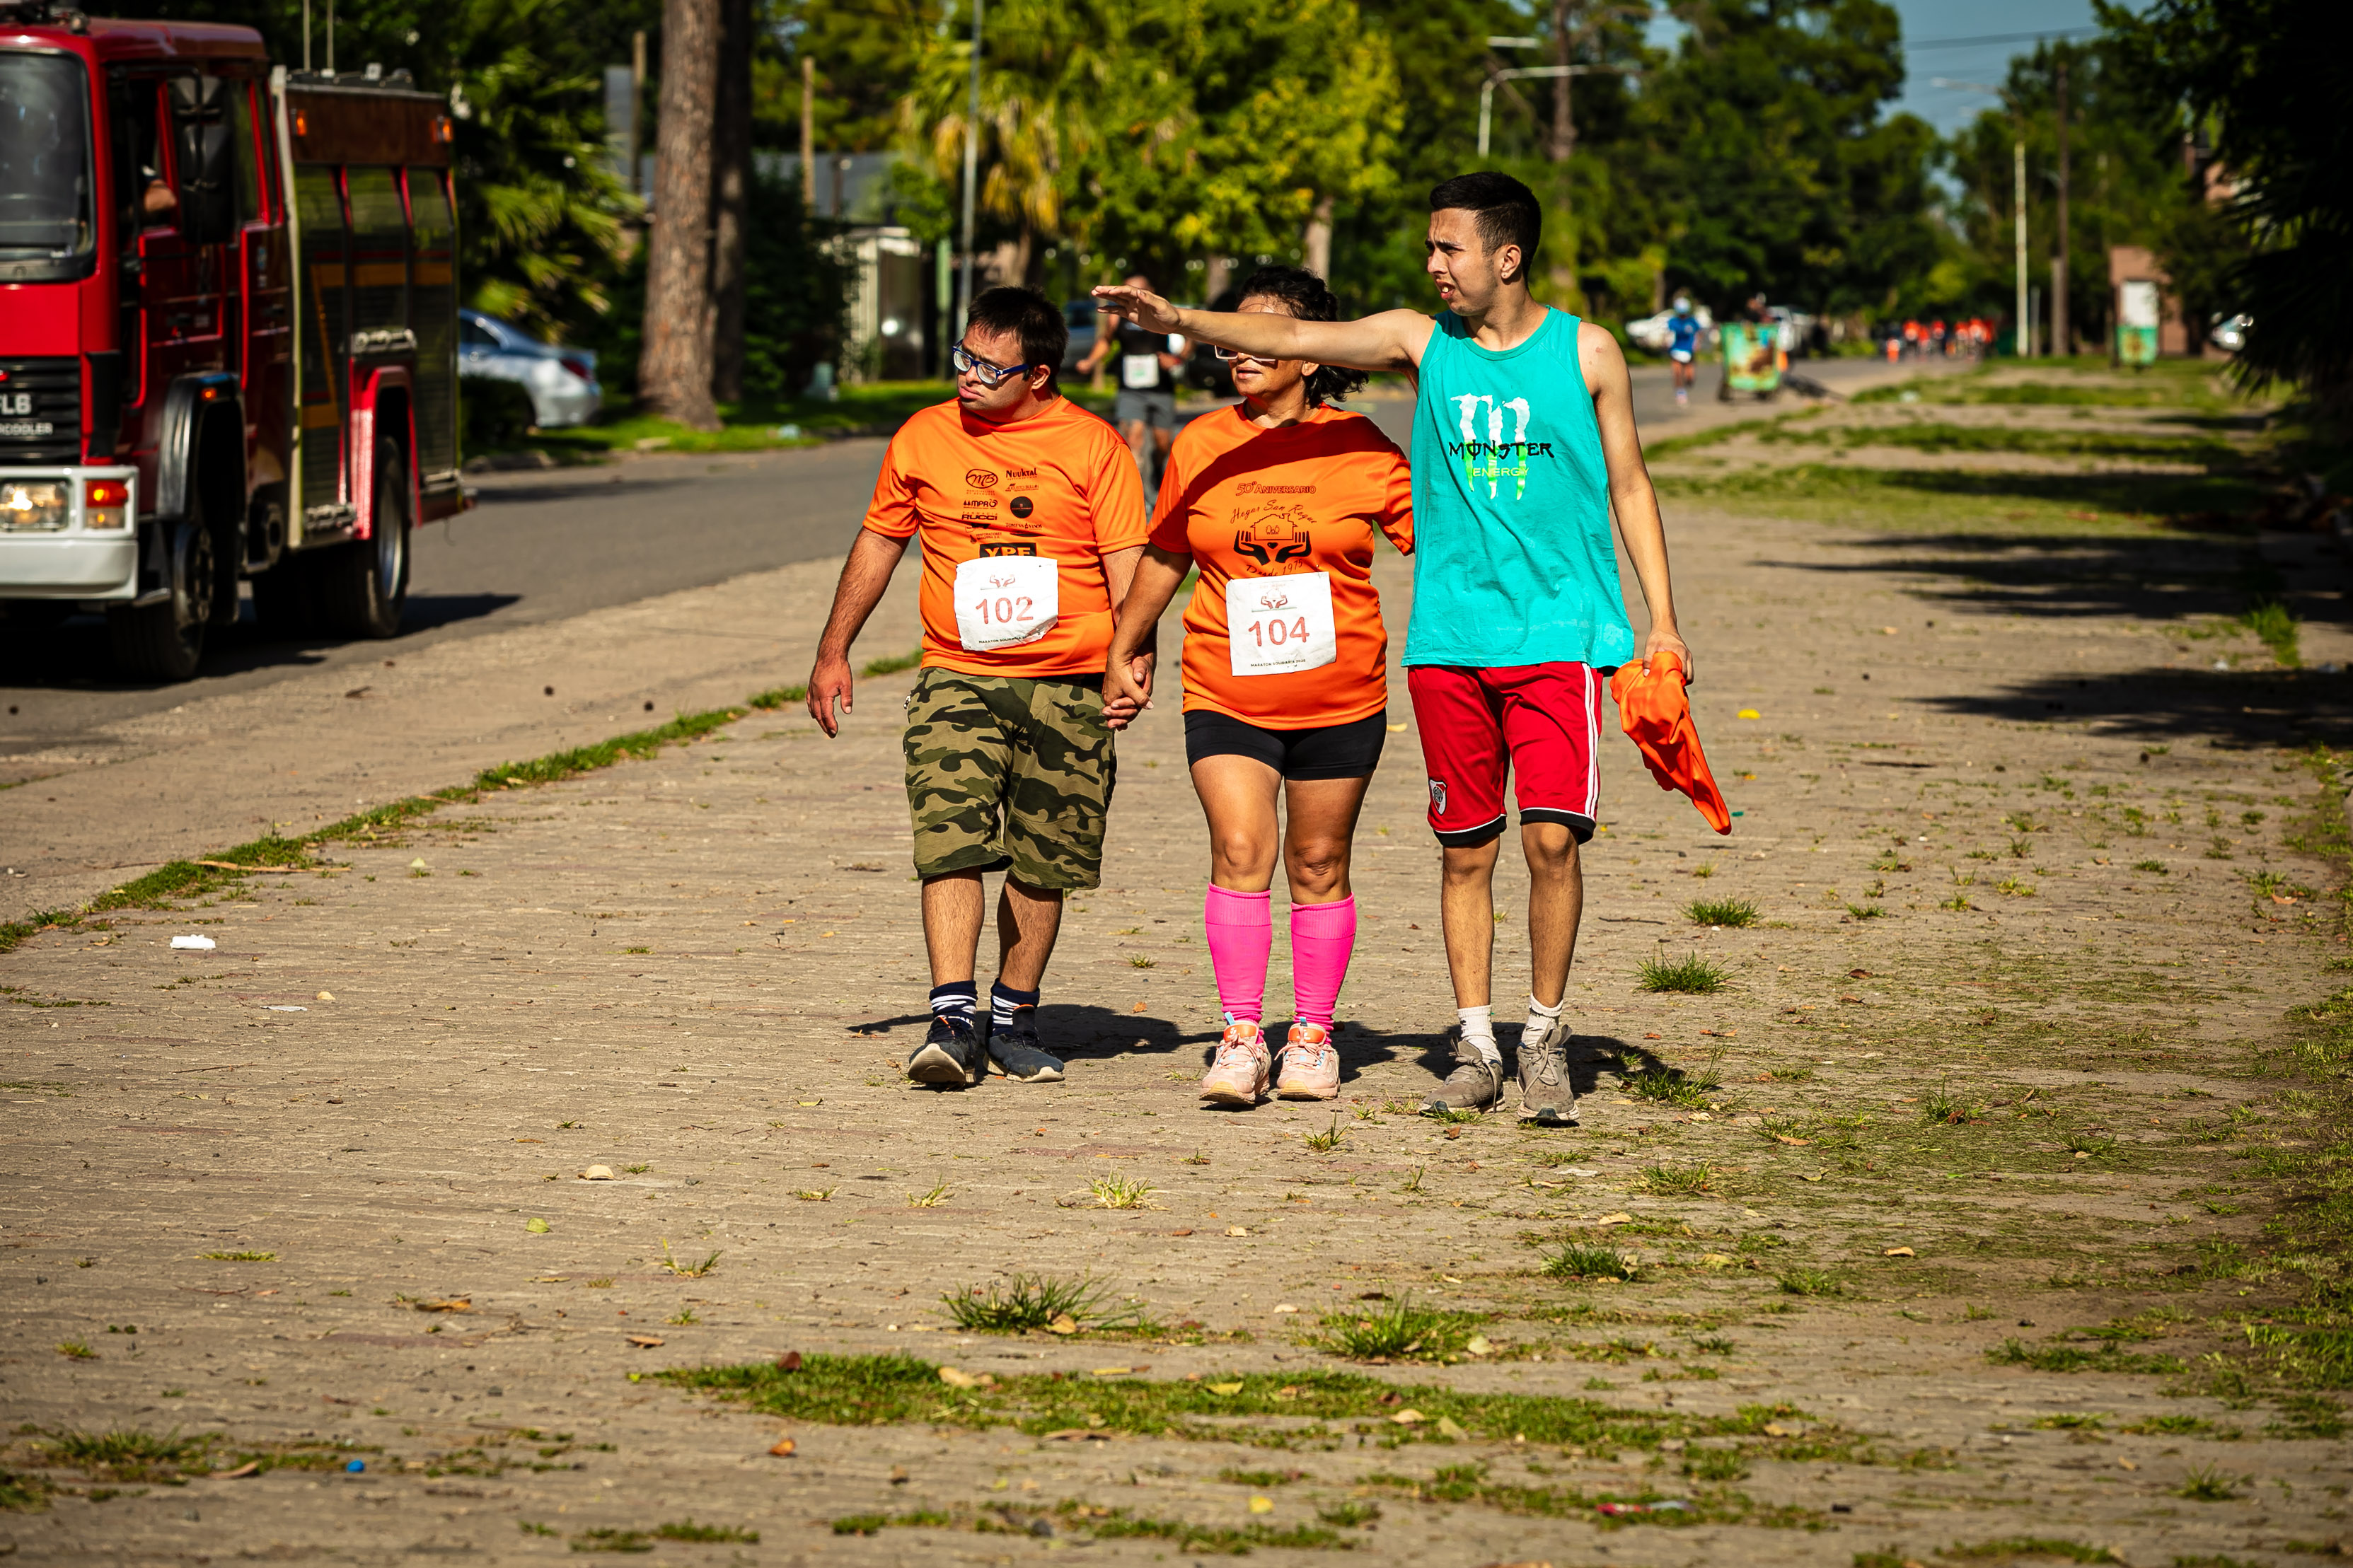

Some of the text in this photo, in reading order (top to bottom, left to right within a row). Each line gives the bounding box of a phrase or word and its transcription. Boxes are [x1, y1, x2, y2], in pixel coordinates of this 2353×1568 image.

[1448, 439, 1555, 460] MONSTER
[1472, 468, 1530, 477] ENERGY
[1230, 507, 1260, 524] Hogar
[1264, 499, 1285, 511] San
[1283, 559, 1302, 575] 1975
[976, 596, 1034, 625] 102
[1248, 617, 1310, 646] 104
